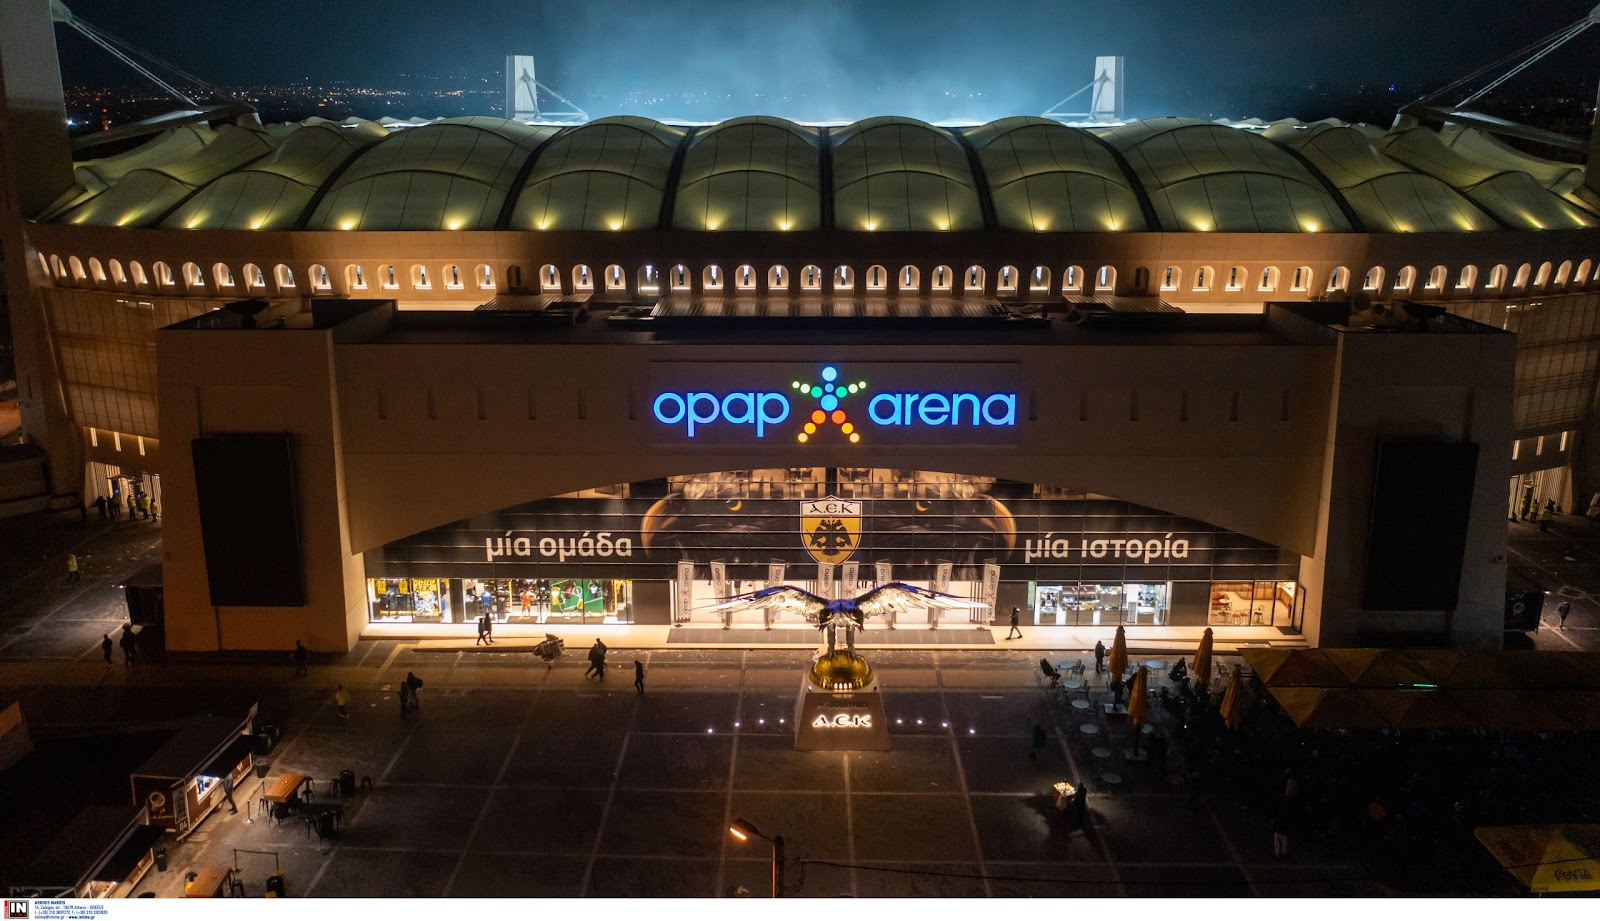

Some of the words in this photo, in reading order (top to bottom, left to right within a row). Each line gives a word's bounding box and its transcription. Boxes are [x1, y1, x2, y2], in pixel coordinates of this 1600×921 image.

[653, 392, 790, 437] opap
[868, 392, 1016, 426] arena
[486, 530, 531, 561] μία
[539, 530, 632, 562] ομάδα
[1025, 532, 1069, 563] μία
[1081, 532, 1189, 563] ιστορία
